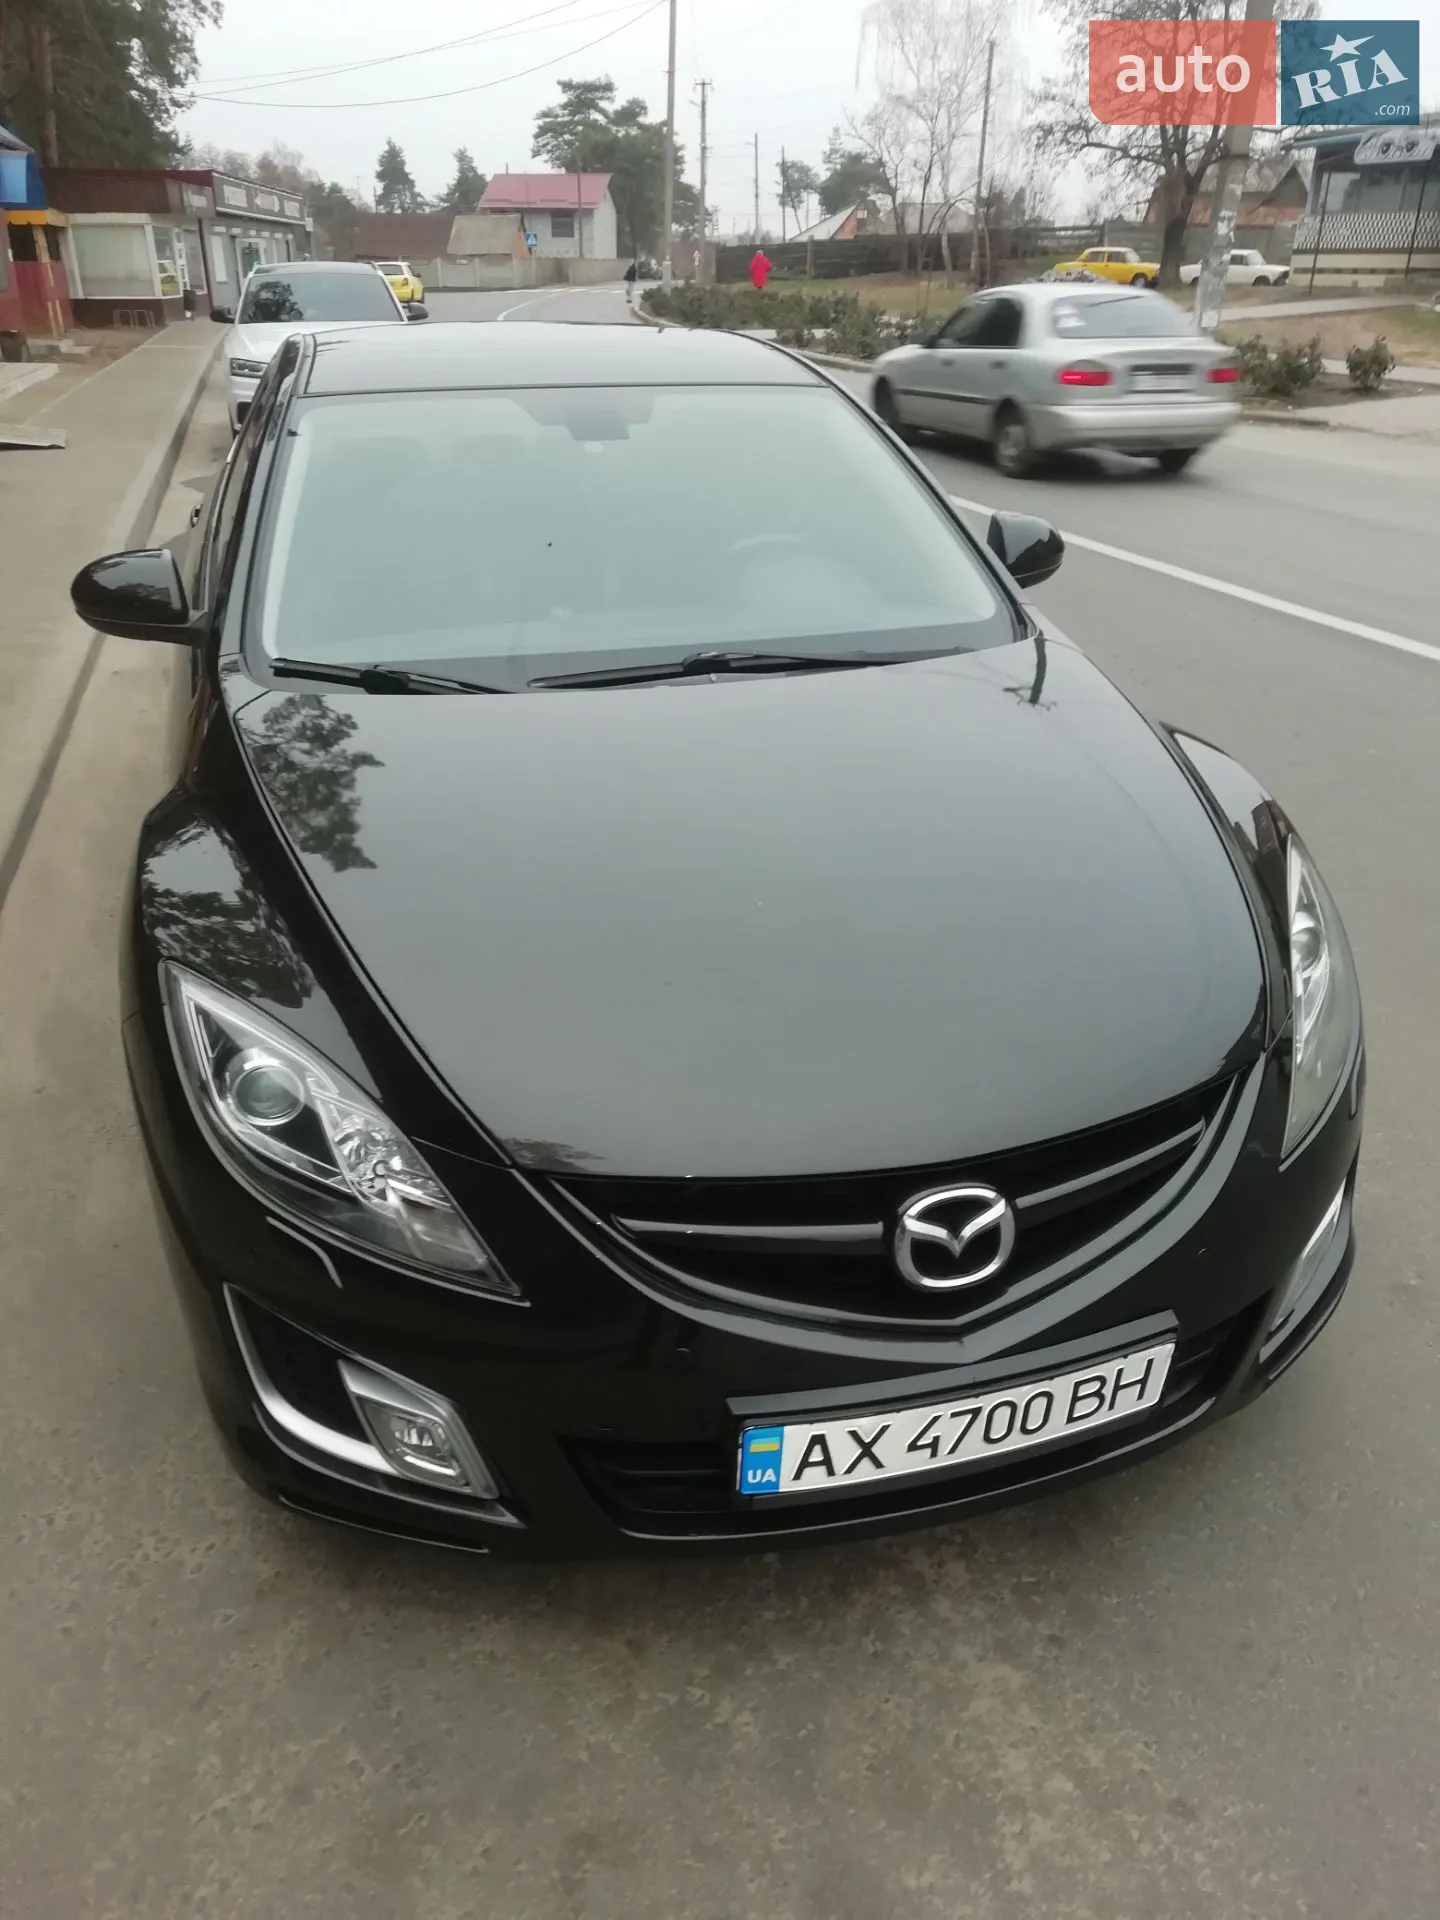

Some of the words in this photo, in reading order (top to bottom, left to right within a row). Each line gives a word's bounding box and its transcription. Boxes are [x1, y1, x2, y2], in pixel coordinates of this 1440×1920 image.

[790, 1424, 892, 1482] AX
[906, 1389, 1053, 1460] 4700
[1065, 1356, 1155, 1426] BH
[747, 1467, 777, 1485] UA
